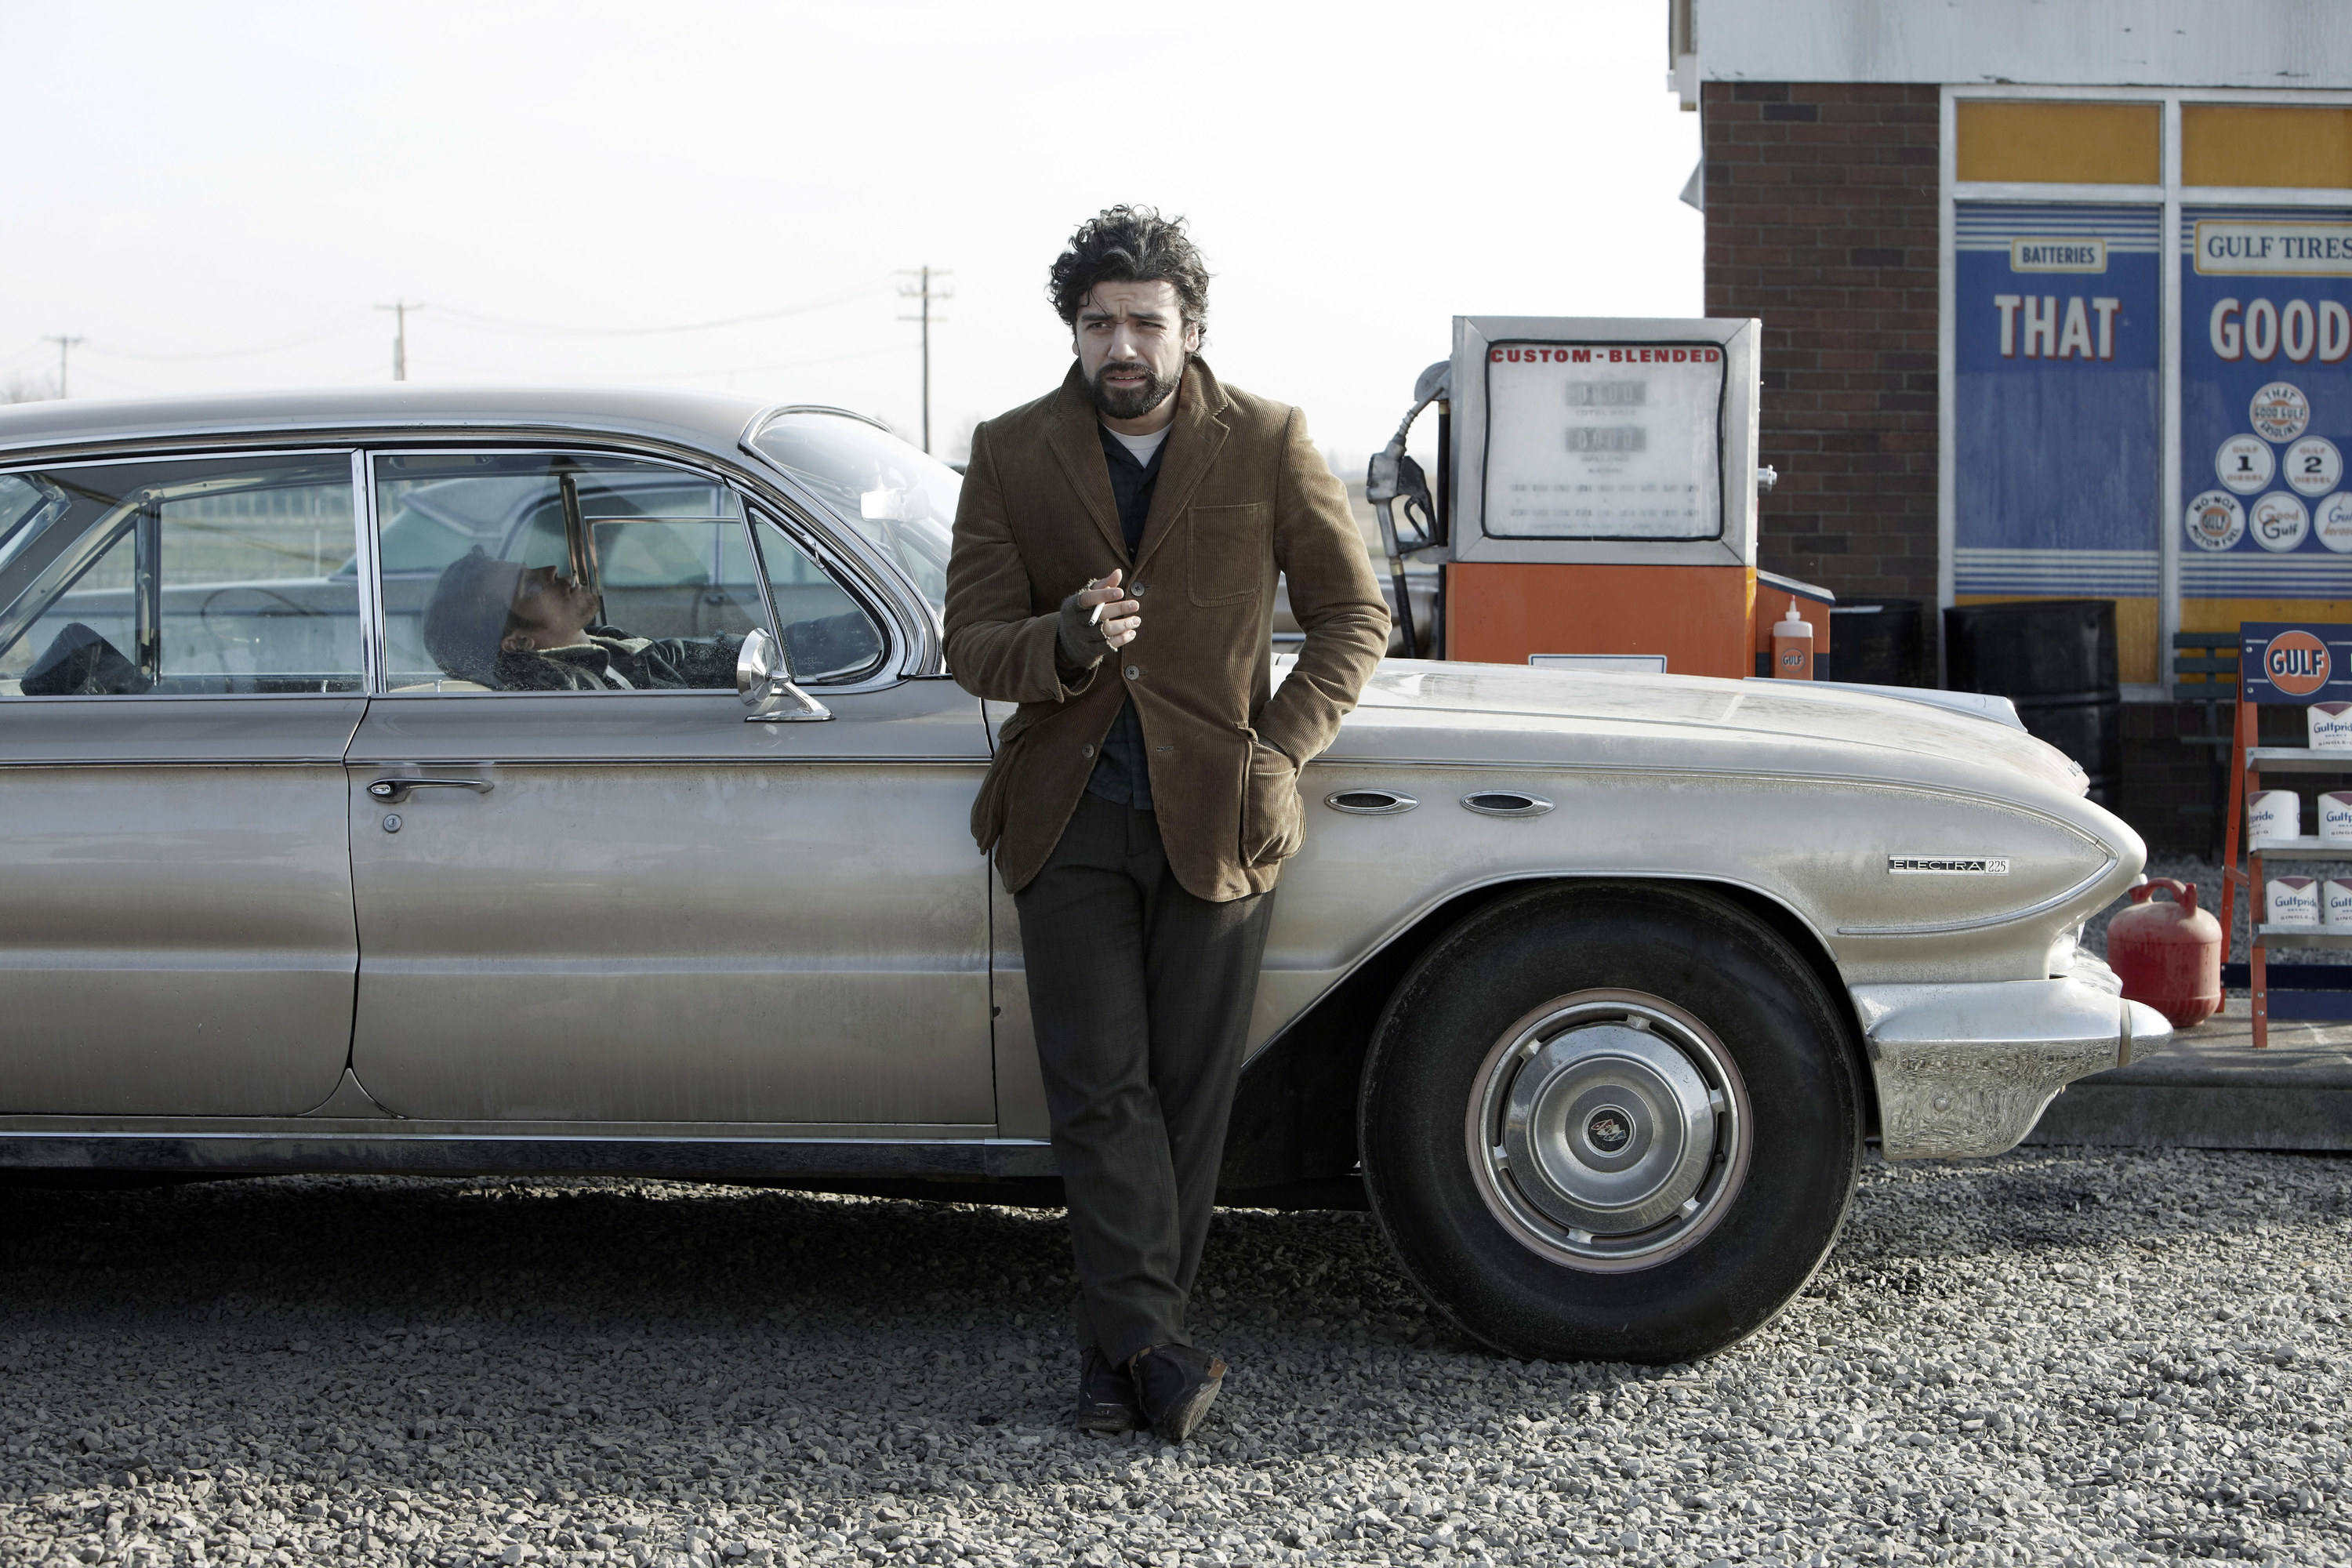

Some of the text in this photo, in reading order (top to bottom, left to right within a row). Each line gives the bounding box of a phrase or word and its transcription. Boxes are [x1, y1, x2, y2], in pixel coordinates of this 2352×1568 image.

[2022, 247, 2095, 264] BATTERIES
[2208, 236, 2352, 260] GULF TIRES
[1994, 295, 2122, 362] THAT
[2209, 297, 2352, 365] GOOD
[1490, 349, 1719, 363] CUSTOM-BLENDED
[2264, 388, 2296, 402] THAT
[2255, 406, 2304, 419] GOOD GULF
[2237, 455, 2253, 473] 1
[2304, 456, 2322, 474] 2
[2226, 474, 2263, 482] DIESEL
[2294, 475, 2332, 485] DIESEL
[2263, 518, 2298, 539] Gulf
[1783, 655, 1802, 666] GULF
[2269, 649, 2325, 677] GULF
[1893, 860, 2006, 873] ELECTRA 225
